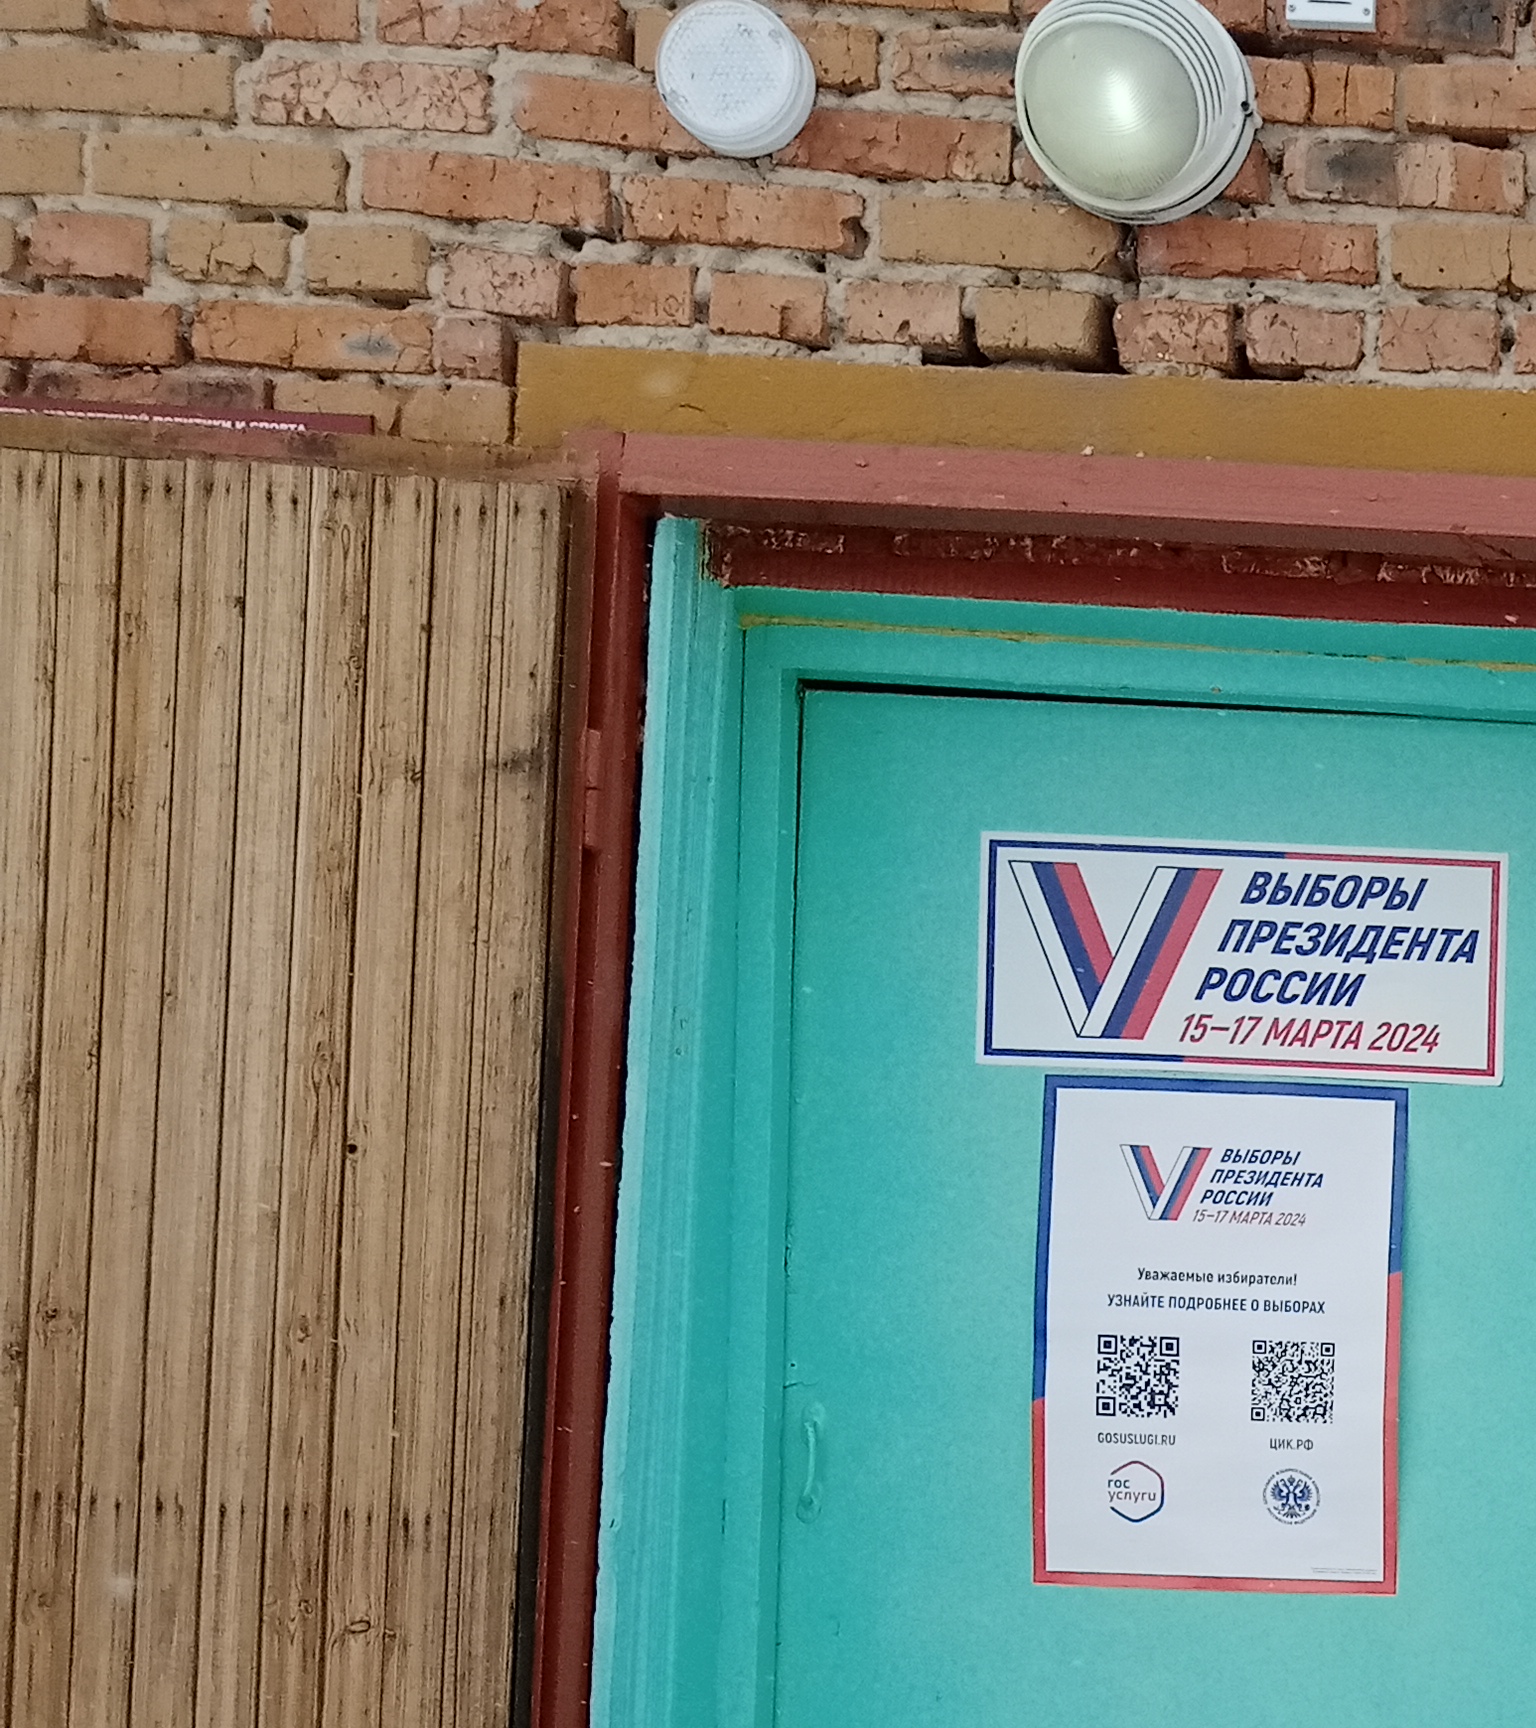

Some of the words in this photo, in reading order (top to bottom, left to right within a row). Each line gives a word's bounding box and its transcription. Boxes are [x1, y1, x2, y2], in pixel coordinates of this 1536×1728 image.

[1241, 872, 1428, 911] ВЫБОРЫ
[1218, 919, 1480, 964] ПРЕЗИДЕНТА
[1195, 967, 1366, 1006] РОССИИ
[1262, 1019, 1363, 1050] МАРТА
[1368, 1022, 1442, 1053] 2024
[1221, 1149, 1300, 1166] ВЫБОРЫ
[1210, 1169, 1324, 1188] ПРЕЗИДЕНТА
[1200, 1190, 1273, 1207] РОССИИ
[1230, 1211, 1272, 1226] МАРТА
[1275, 1212, 1307, 1227] 2024
[1137, 1268, 1213, 1283] Уважаемые
[1217, 1269, 1297, 1286] избиратели!
[1107, 1292, 1165, 1308] УЗНАЙТЕ
[1168, 1296, 1247, 1312] ПОДРОБНЕЕ
[1250, 1299, 1259, 1311] О
[1264, 1300, 1326, 1314] ВЫБОРАХ
[1097, 1432, 1176, 1446] GOSUSLUGI.RU
[1269, 1438, 1314, 1451] ЦИК.РФ
[1107, 1478, 1130, 1489] гос
